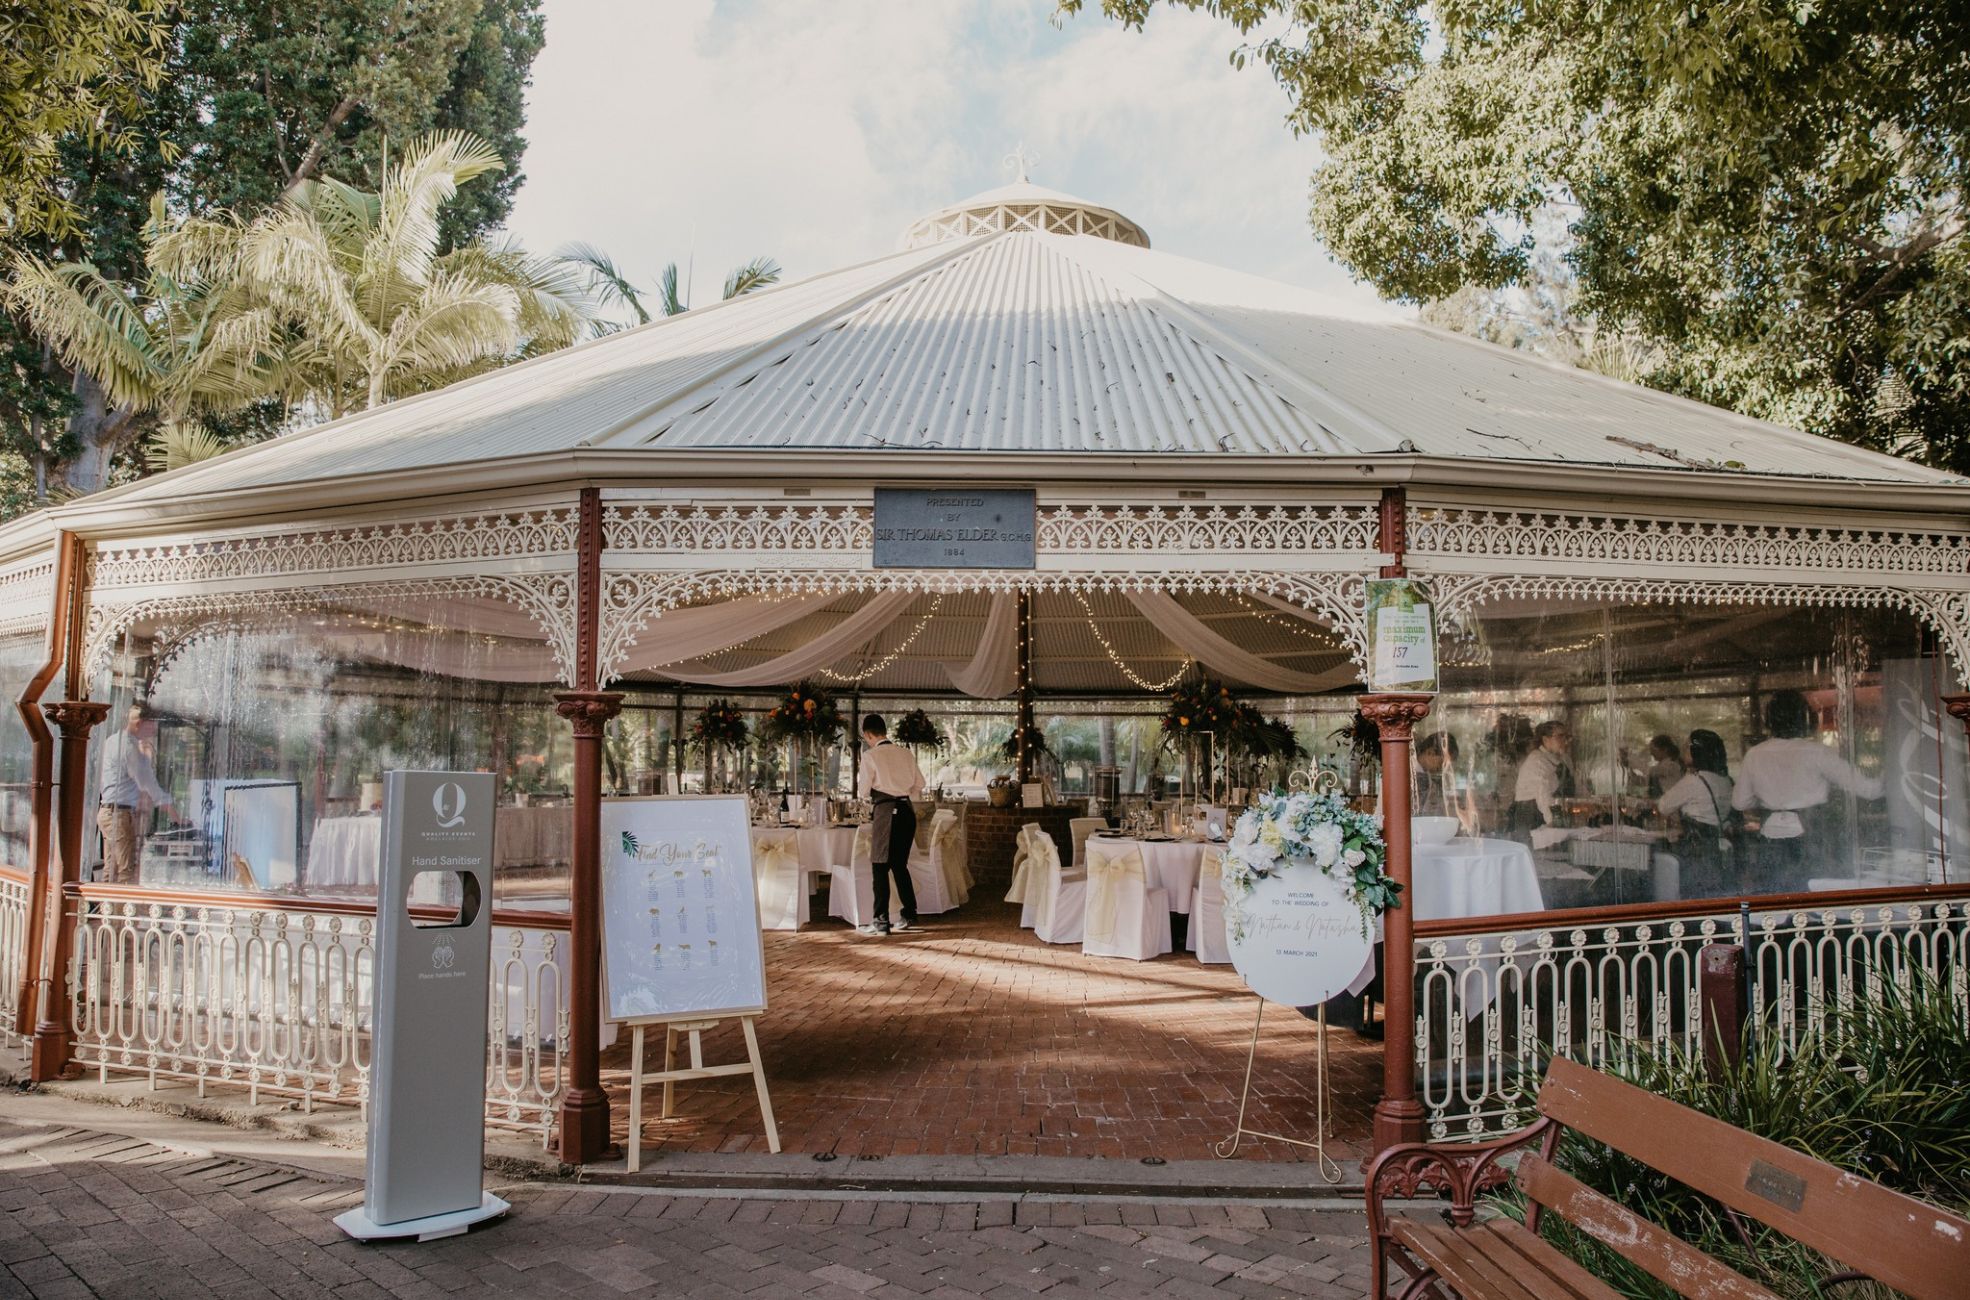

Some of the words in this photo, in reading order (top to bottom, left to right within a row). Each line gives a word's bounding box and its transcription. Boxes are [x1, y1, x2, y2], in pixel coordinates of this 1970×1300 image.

[926, 498, 984, 507] PRESENTED
[946, 513, 961, 522] BY
[876, 528, 896, 542] SIR
[896, 528, 954, 542] THOMAS
[956, 528, 999, 542] ELDER
[1383, 624, 1426, 634] maximum
[1383, 634, 1420, 646] capacity
[1392, 647, 1408, 659] 157
[432, 782, 467, 828] Q
[637, 844, 658, 862] Find
[659, 843, 692, 866] Your
[696, 842, 722, 859] Seat
[412, 856, 438, 866] Hand
[440, 855, 481, 866] Sanitiser
[1305, 913, 1359, 939] Natasha
